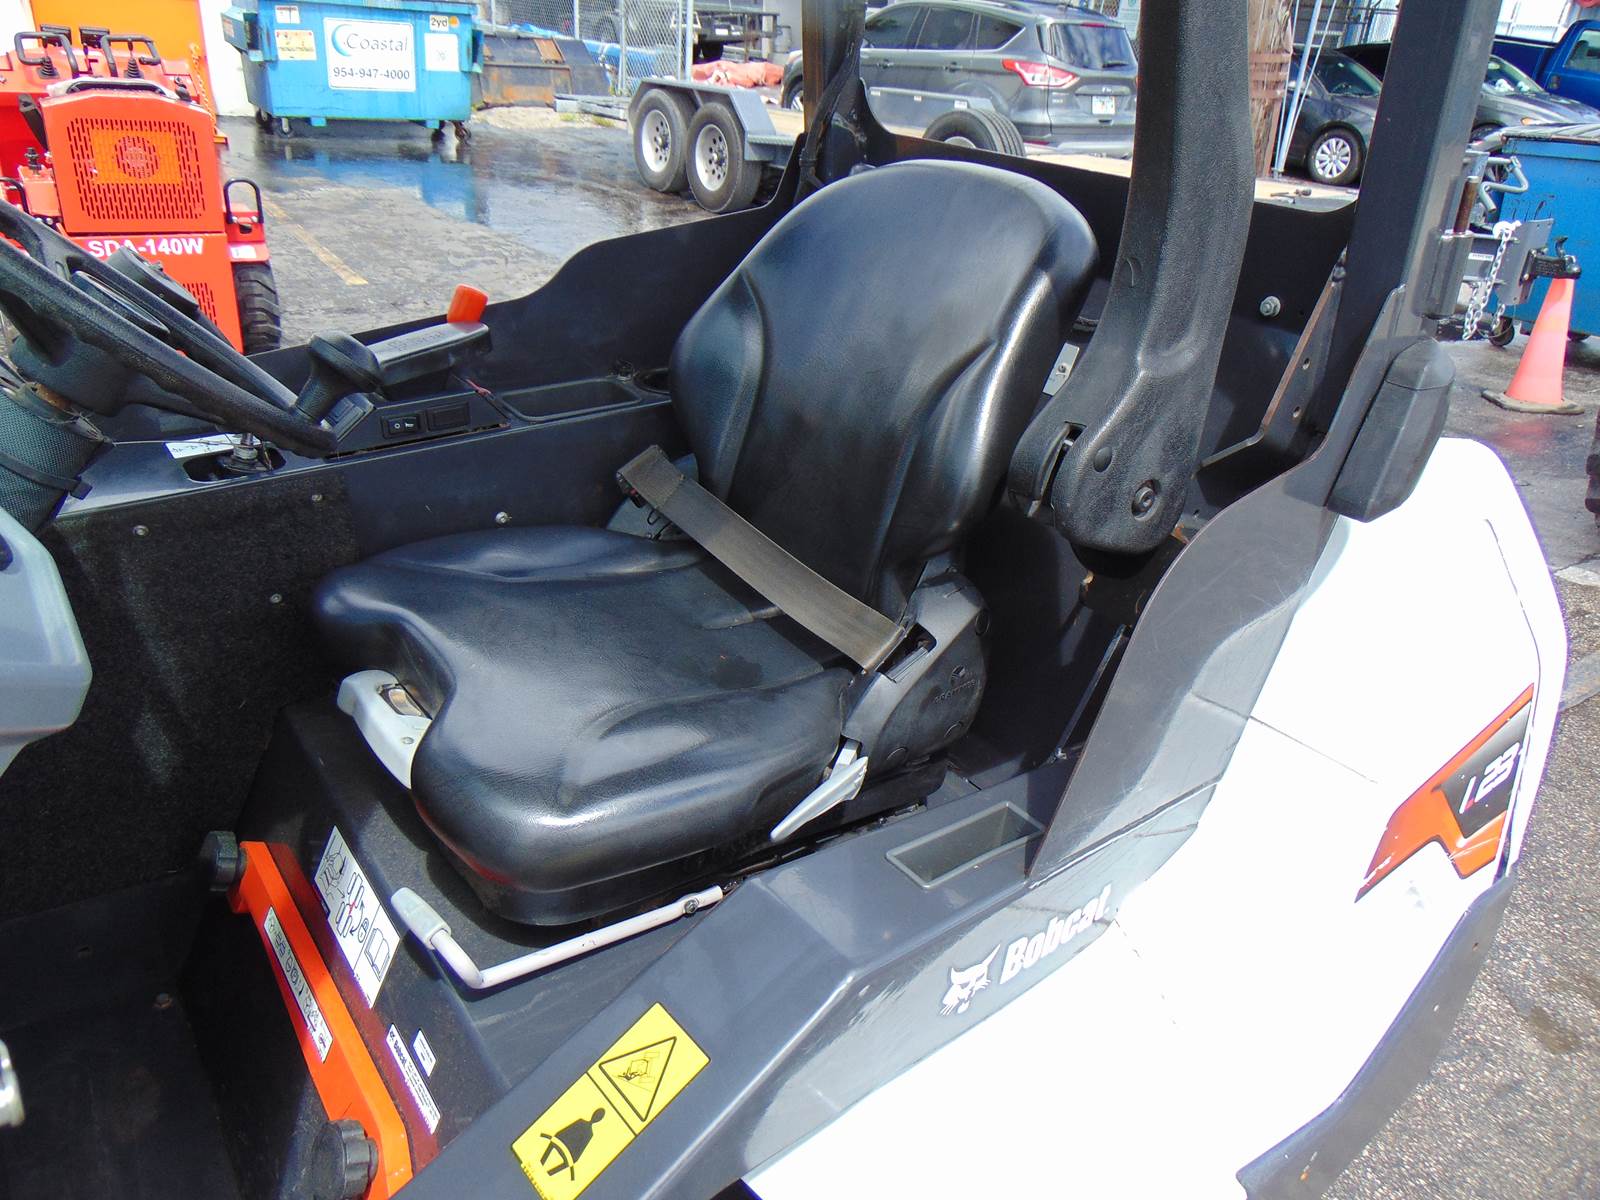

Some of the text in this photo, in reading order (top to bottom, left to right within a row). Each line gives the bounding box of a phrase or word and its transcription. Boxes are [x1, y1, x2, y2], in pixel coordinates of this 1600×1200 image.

[431, 17, 448, 28] 2yd
[347, 33, 408, 51] Coastal
[333, 66, 410, 80] 954-947-4000
[88, 237, 203, 258] SDA-140W
[1000, 883, 1111, 985] Bobcat
